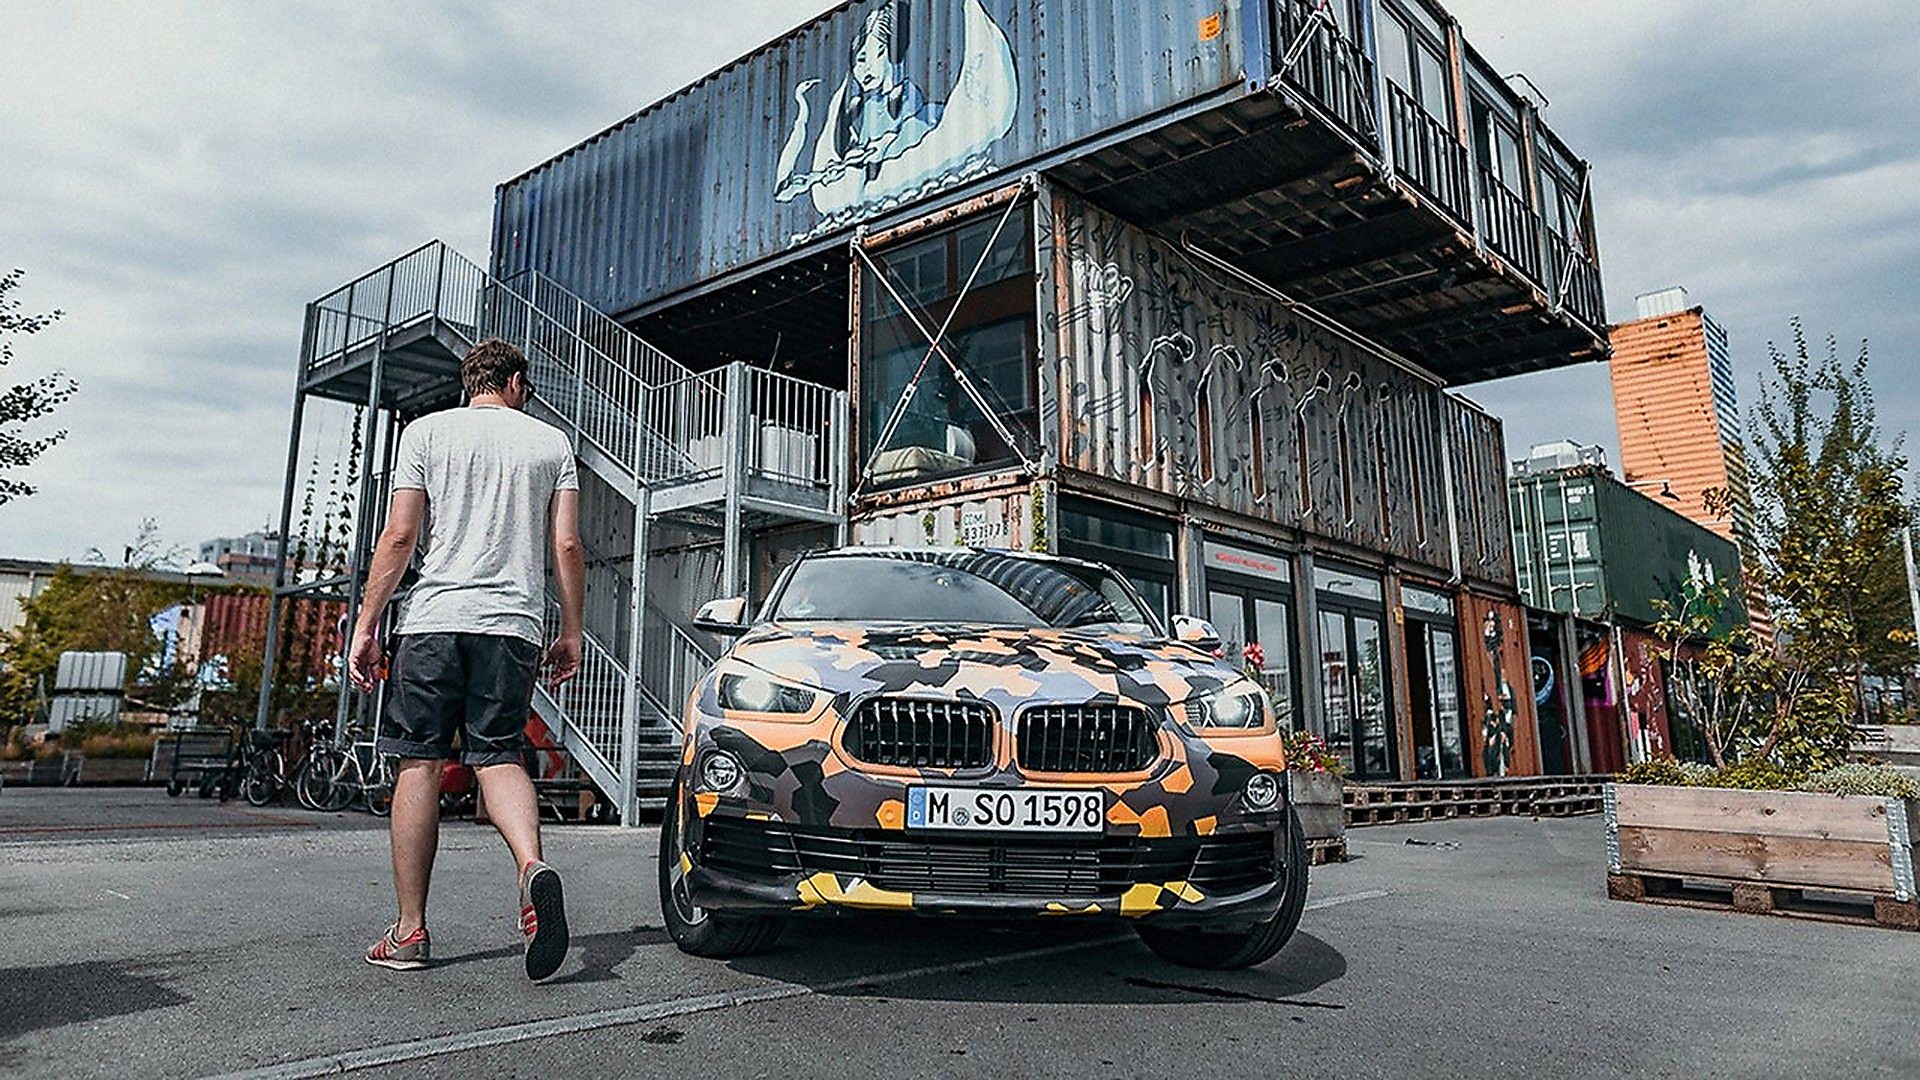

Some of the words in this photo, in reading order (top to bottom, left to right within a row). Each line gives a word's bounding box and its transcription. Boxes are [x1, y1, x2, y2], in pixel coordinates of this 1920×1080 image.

[913, 811, 920, 820] D
[928, 792, 949, 824] M
[974, 793, 1015, 826] SO
[1023, 795, 1101, 827] 1598
